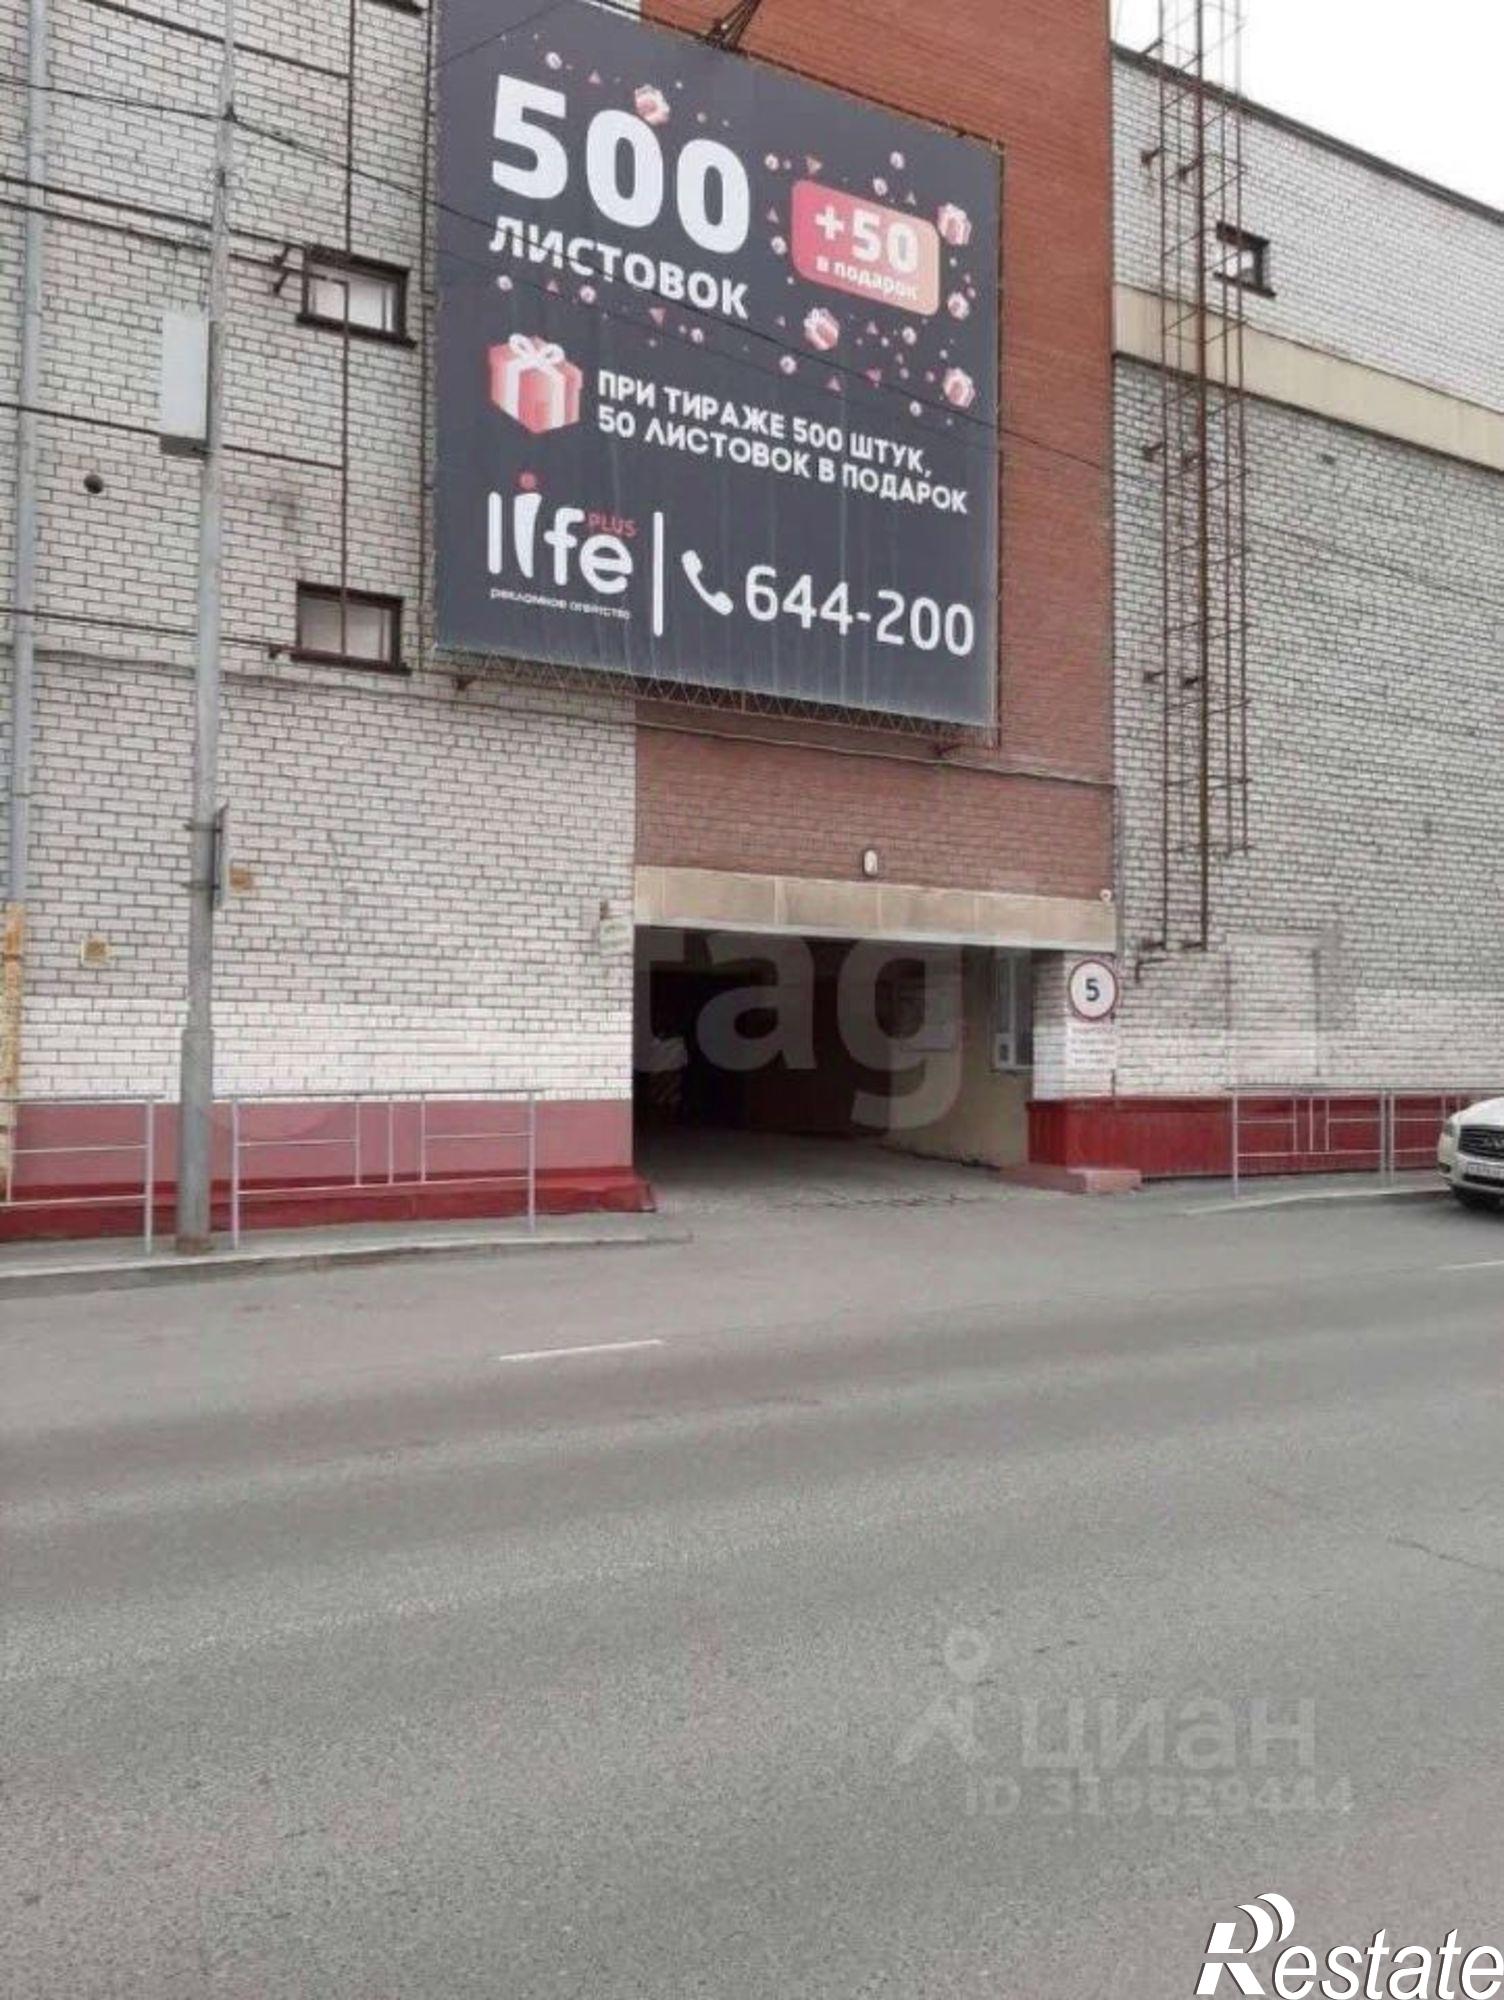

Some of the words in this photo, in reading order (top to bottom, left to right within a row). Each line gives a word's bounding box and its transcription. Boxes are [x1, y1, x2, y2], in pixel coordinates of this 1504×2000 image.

[492, 75, 750, 253] 500
[489, 216, 749, 319] ЛИСТОВОК
[814, 204, 918, 274] +50
[834, 261, 917, 300] подарок
[598, 369, 656, 409] ПРИ
[663, 386, 785, 439] ТИРАЖЕ
[793, 417, 843, 451] 500
[850, 432, 932, 478] ШТУК,
[598, 405, 636, 438] 50
[645, 417, 811, 478] ЛИСТОВОК
[818, 457, 835, 482] В
[842, 462, 967, 514] ПОДАРОК
[488, 471, 634, 595] life
[587, 512, 637, 537] PLUS
[745, 564, 974, 656] 644-200
[1085, 977, 1101, 1003] 5
